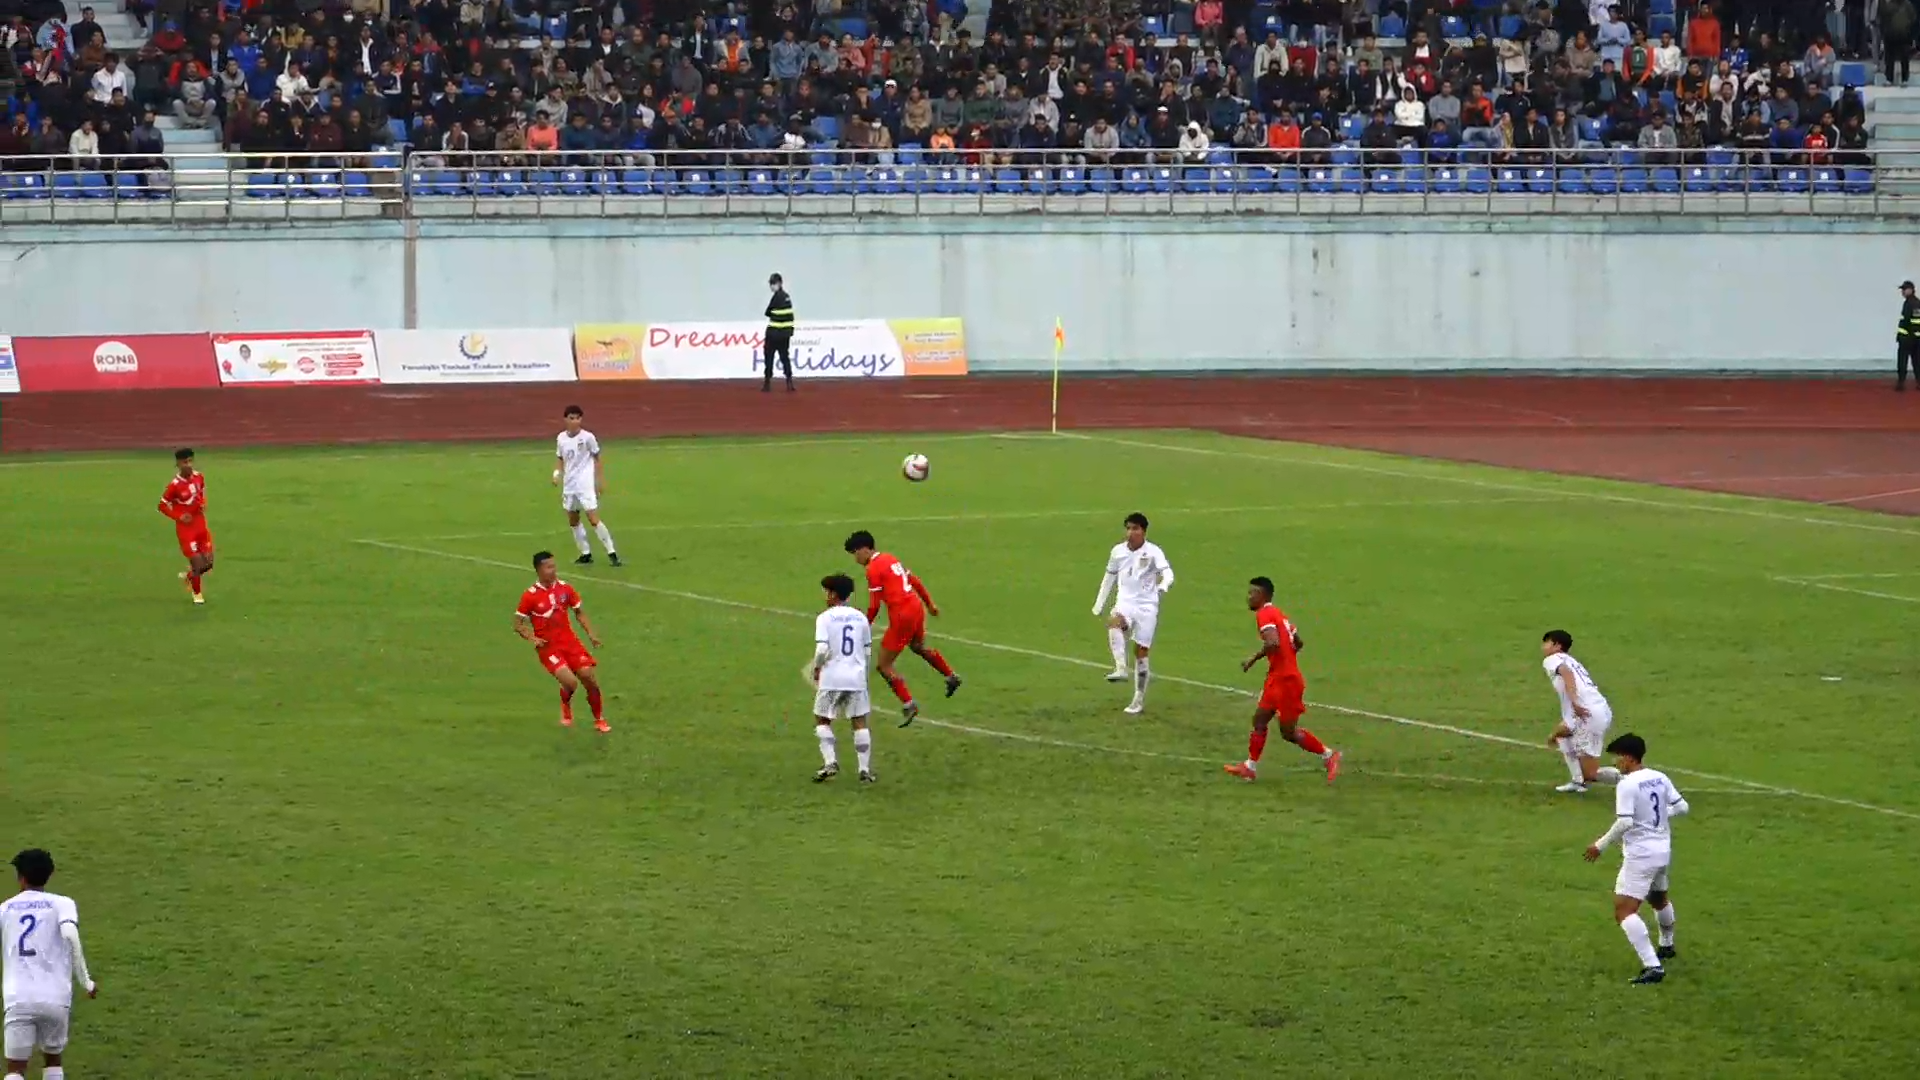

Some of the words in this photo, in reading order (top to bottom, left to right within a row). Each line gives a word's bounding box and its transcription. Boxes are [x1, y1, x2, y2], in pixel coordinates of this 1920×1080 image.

[649, 328, 764, 349] Dreams
[841, 624, 854, 656] 6
[1650, 792, 1660, 827] 3
[19, 914, 36, 956] 2
